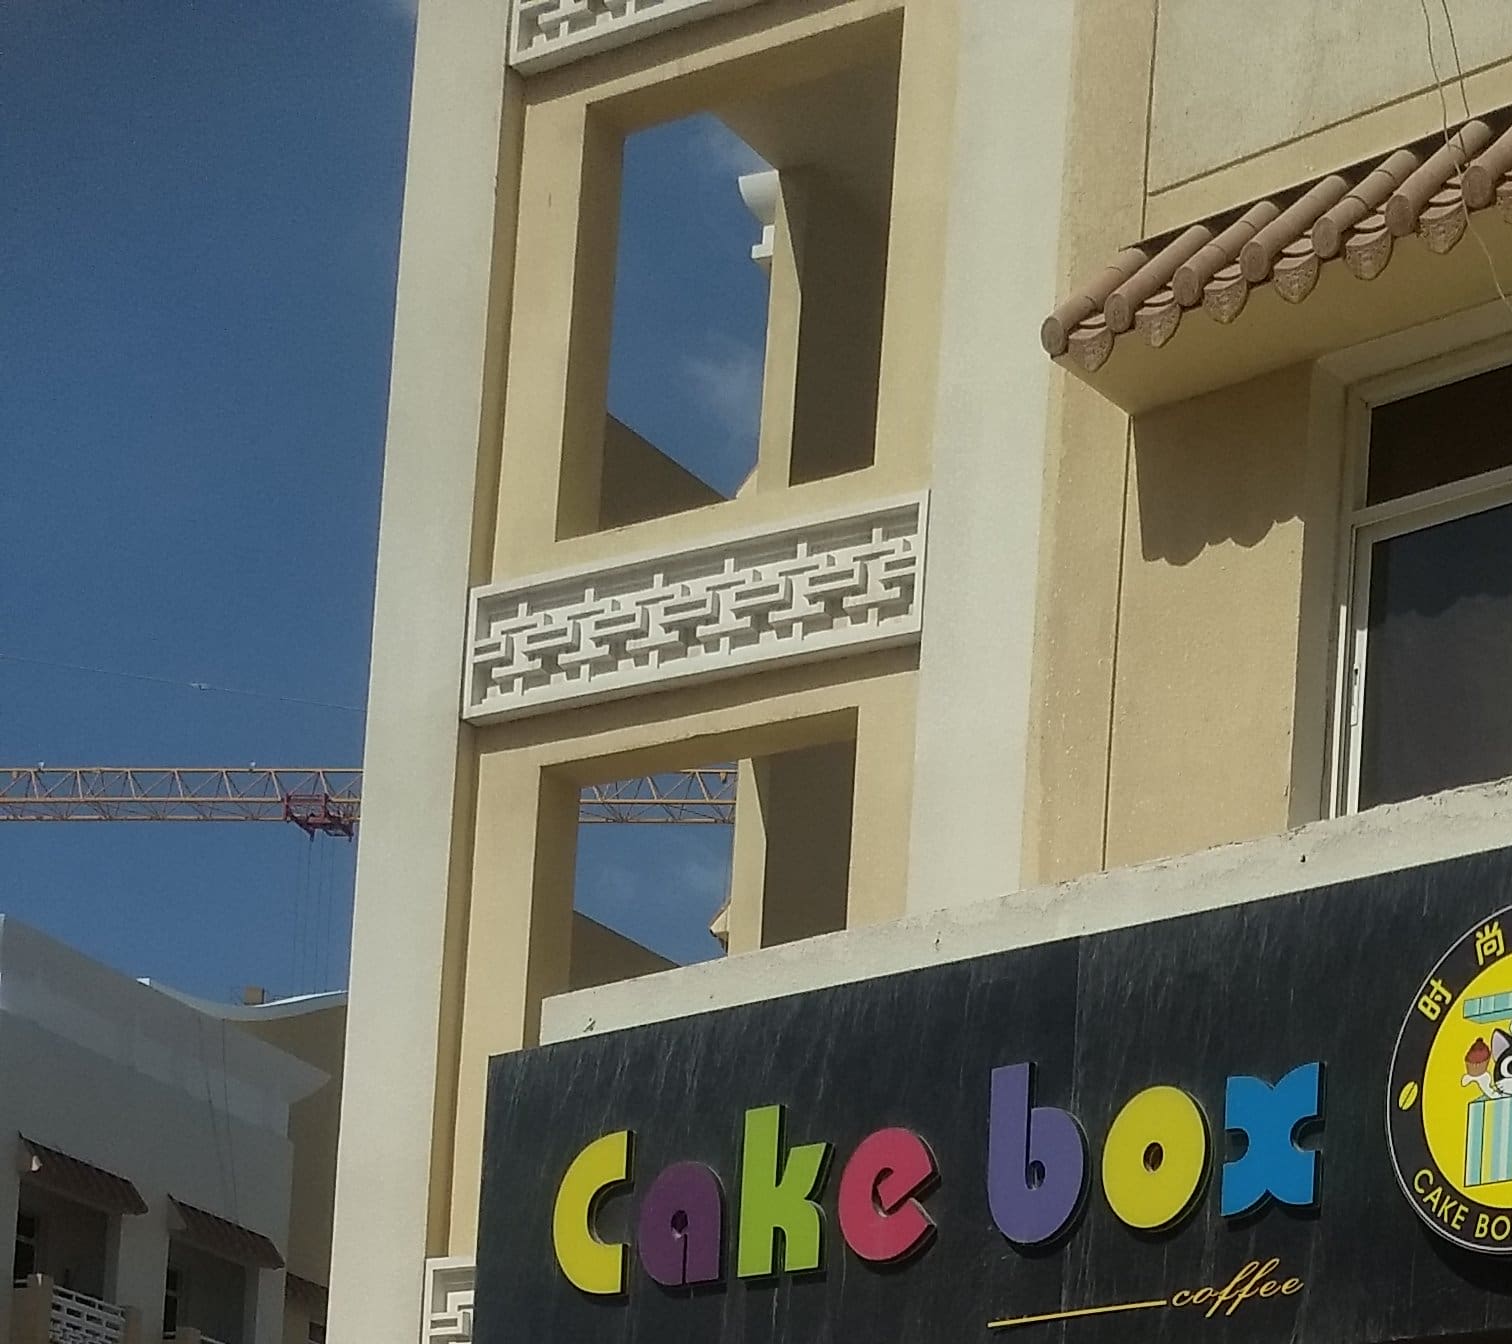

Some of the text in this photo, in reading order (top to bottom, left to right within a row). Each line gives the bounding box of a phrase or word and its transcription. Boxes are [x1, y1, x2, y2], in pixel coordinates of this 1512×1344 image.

[987, 1061, 1323, 1246] box
[1412, 1168, 1469, 1231] CAKE
[1172, 1257, 1304, 1318] coffee
